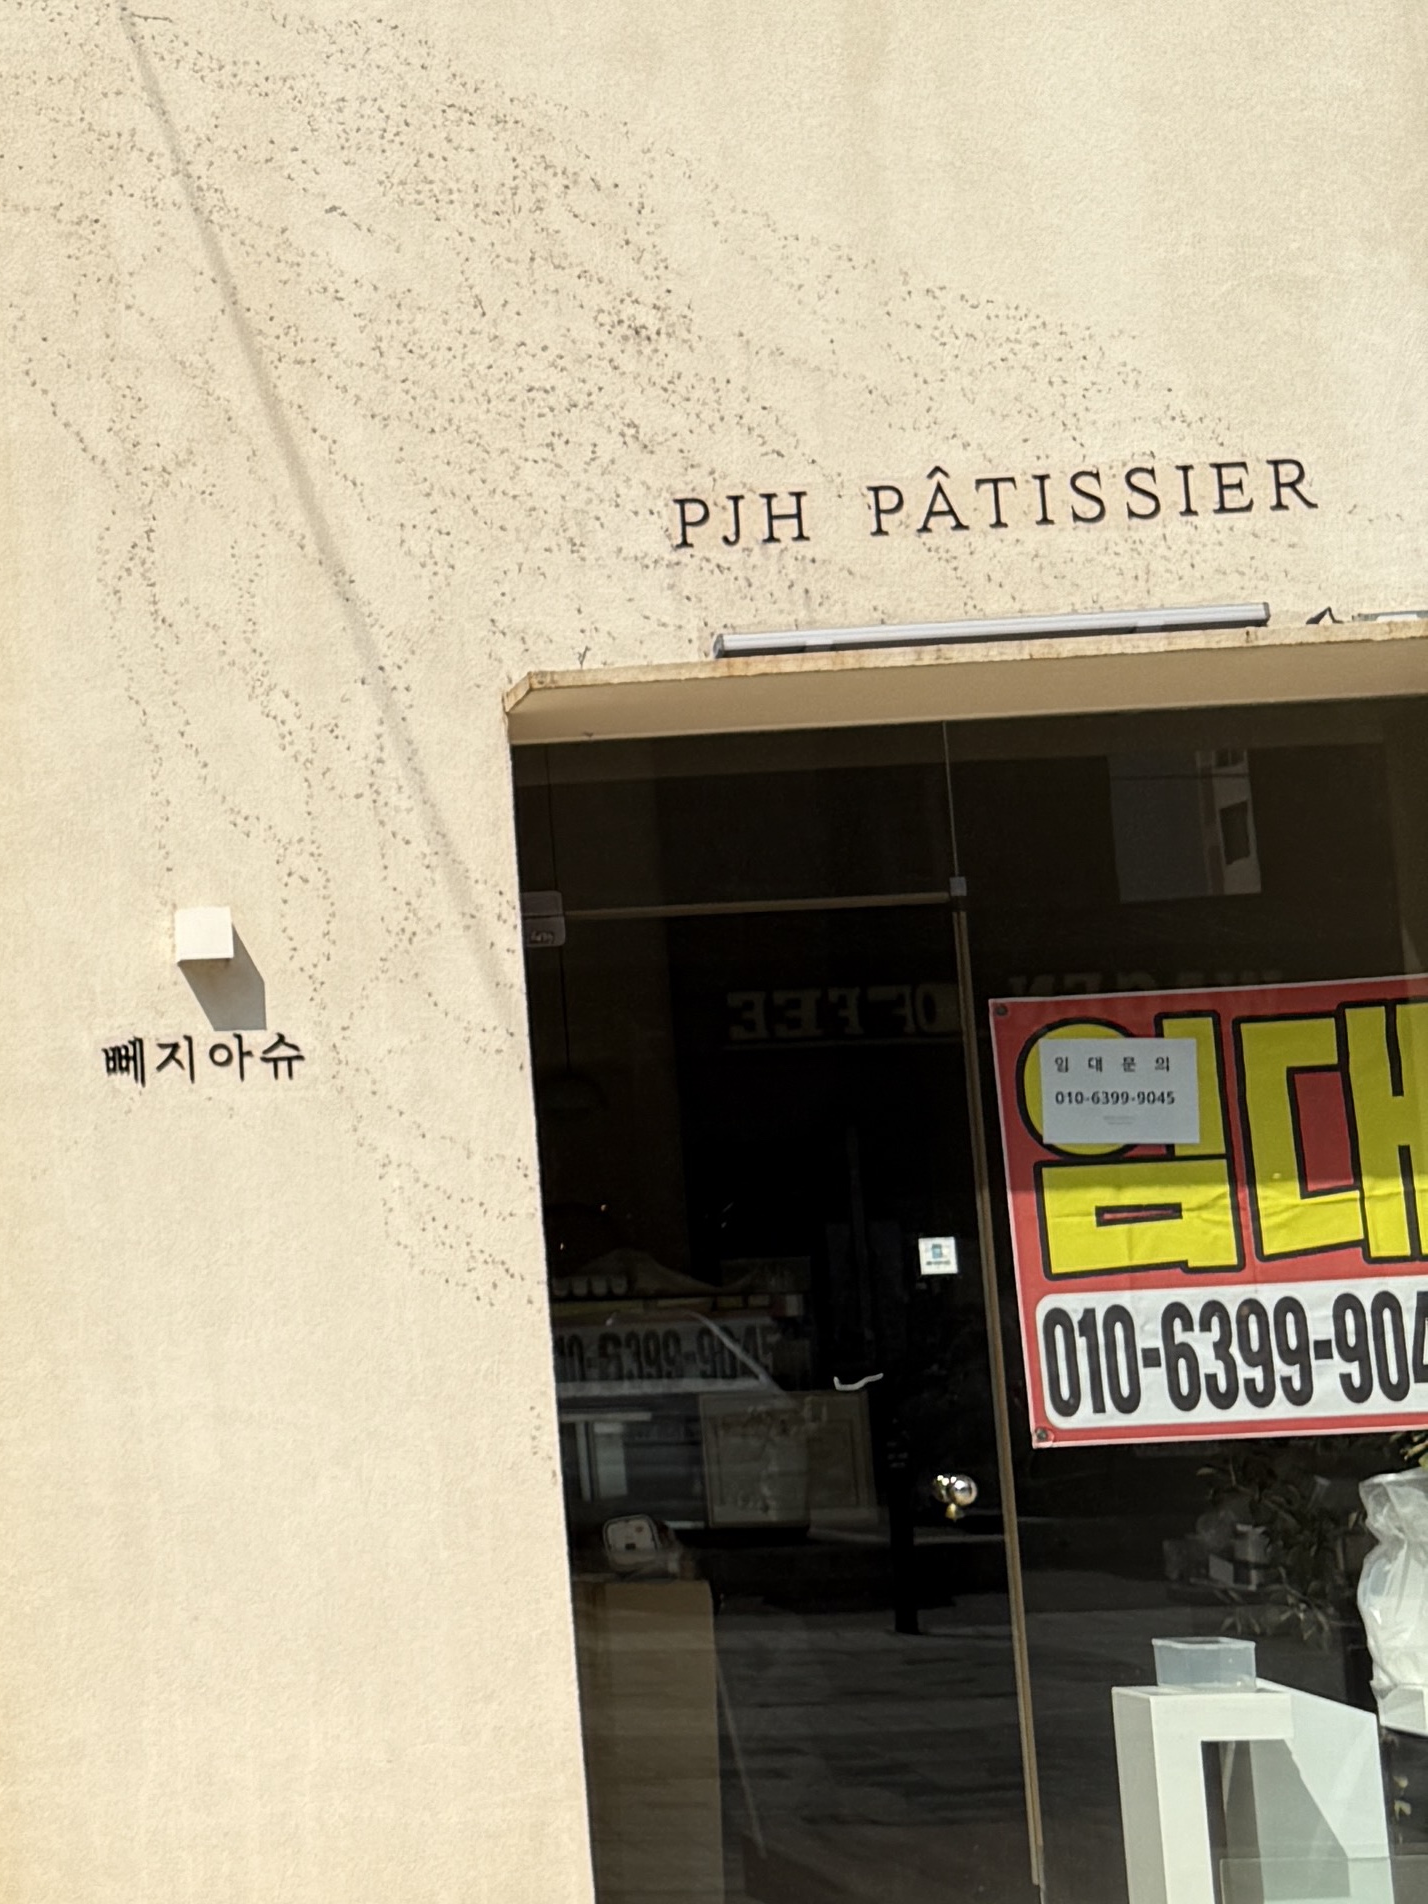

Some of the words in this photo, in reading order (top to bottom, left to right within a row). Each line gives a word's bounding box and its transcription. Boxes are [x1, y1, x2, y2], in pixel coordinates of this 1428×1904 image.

[672, 490, 811, 549] PJH
[867, 458, 1319, 536] PÂTISSIER
[1054, 1090, 1176, 1105] 010-6399-9045
